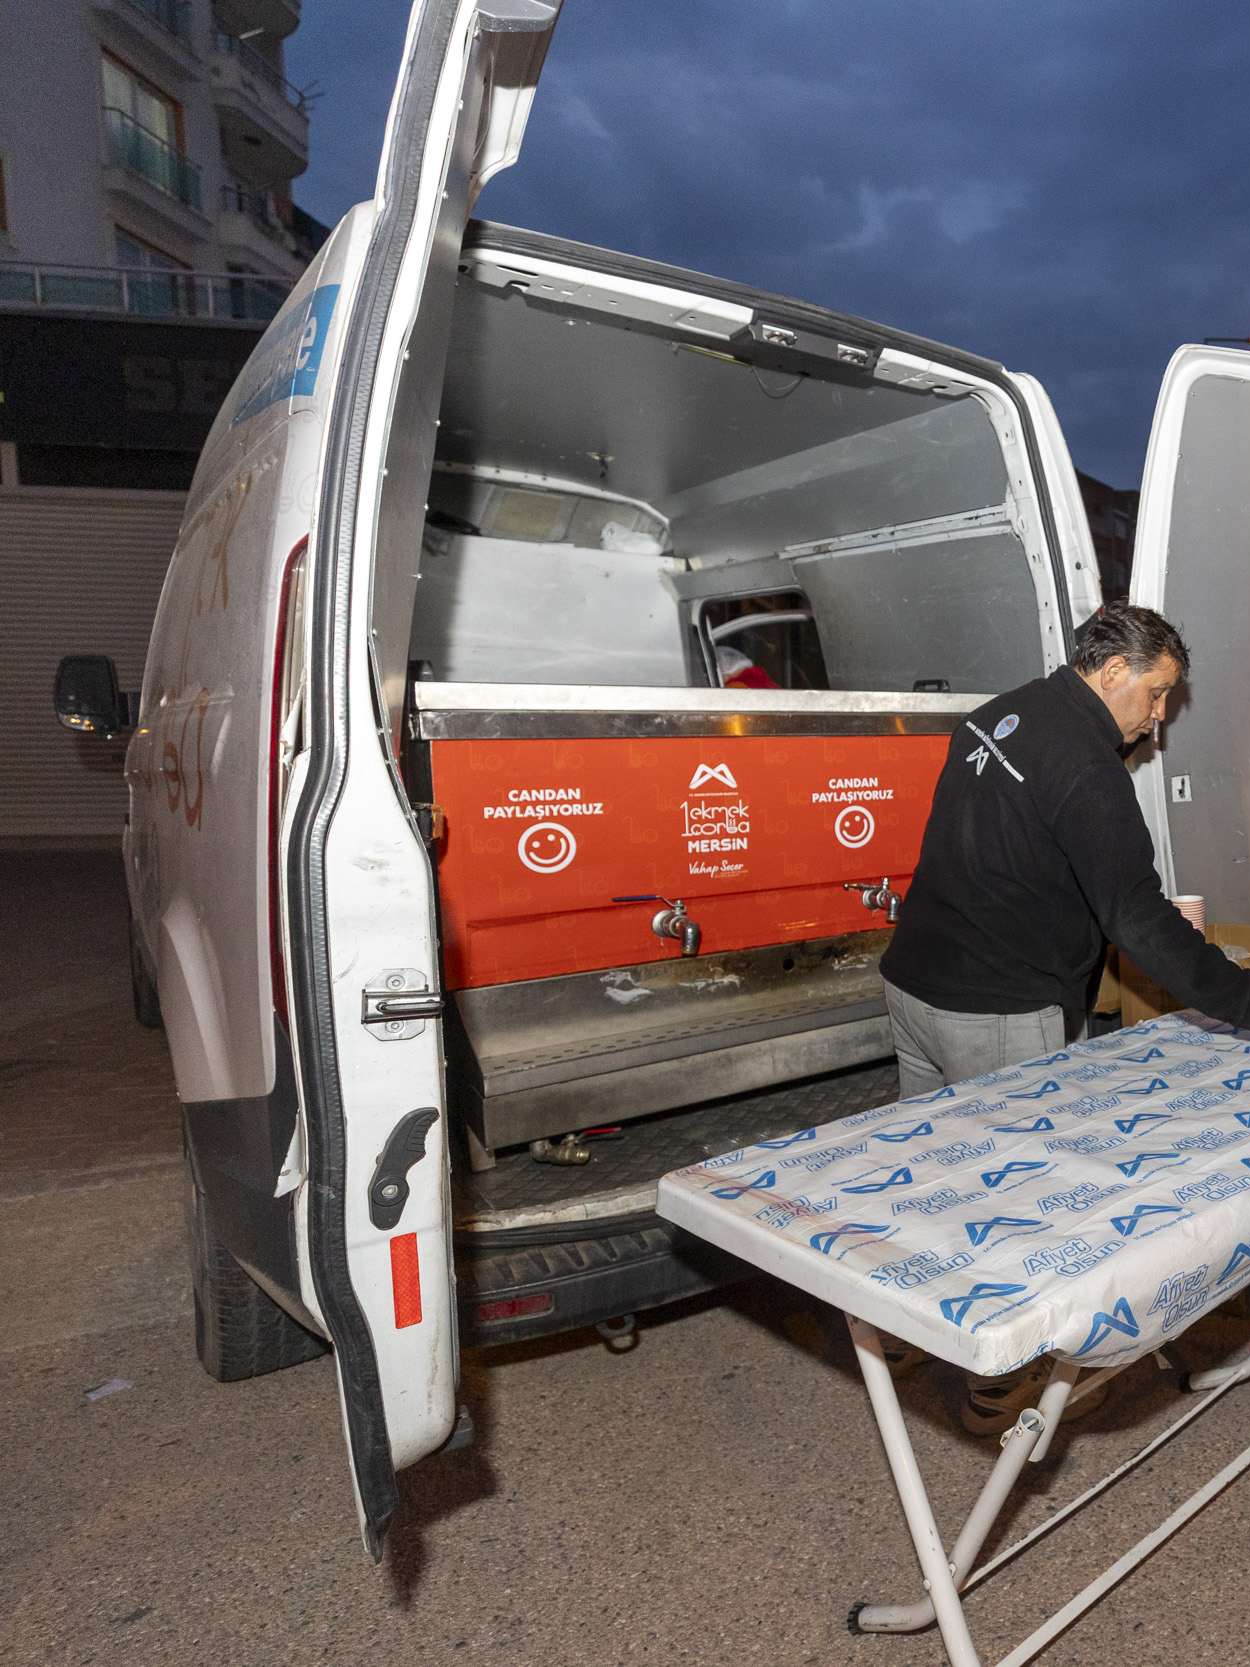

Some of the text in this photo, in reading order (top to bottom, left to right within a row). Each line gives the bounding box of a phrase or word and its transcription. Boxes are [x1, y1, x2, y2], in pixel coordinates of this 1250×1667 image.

[508, 788, 581, 802] CANDAN
[812, 789, 894, 804] PAYLAŞIYORUZ
[827, 777, 879, 789] CANDAN
[483, 803, 604, 820] PAYLAŞIYORUZ
[779, 1146, 845, 1169] Olsun
[807, 1142, 868, 1173] Afiyet
[909, 1141, 971, 1165] Olsun
[937, 1138, 996, 1166] Afiyet
[891, 1188, 958, 1216] Afiyet
[1037, 1181, 1100, 1216] Afiyet
[1066, 1183, 1130, 1213] Olsun
[1172, 1173, 1230, 1204] Afiyet
[919, 1191, 989, 1215] Olsun
[894, 1251, 976, 1290] Olsun
[1022, 1237, 1092, 1277] Afiyet
[1055, 1239, 1127, 1278] Olsun
[1147, 1264, 1210, 1317] Afiyet
